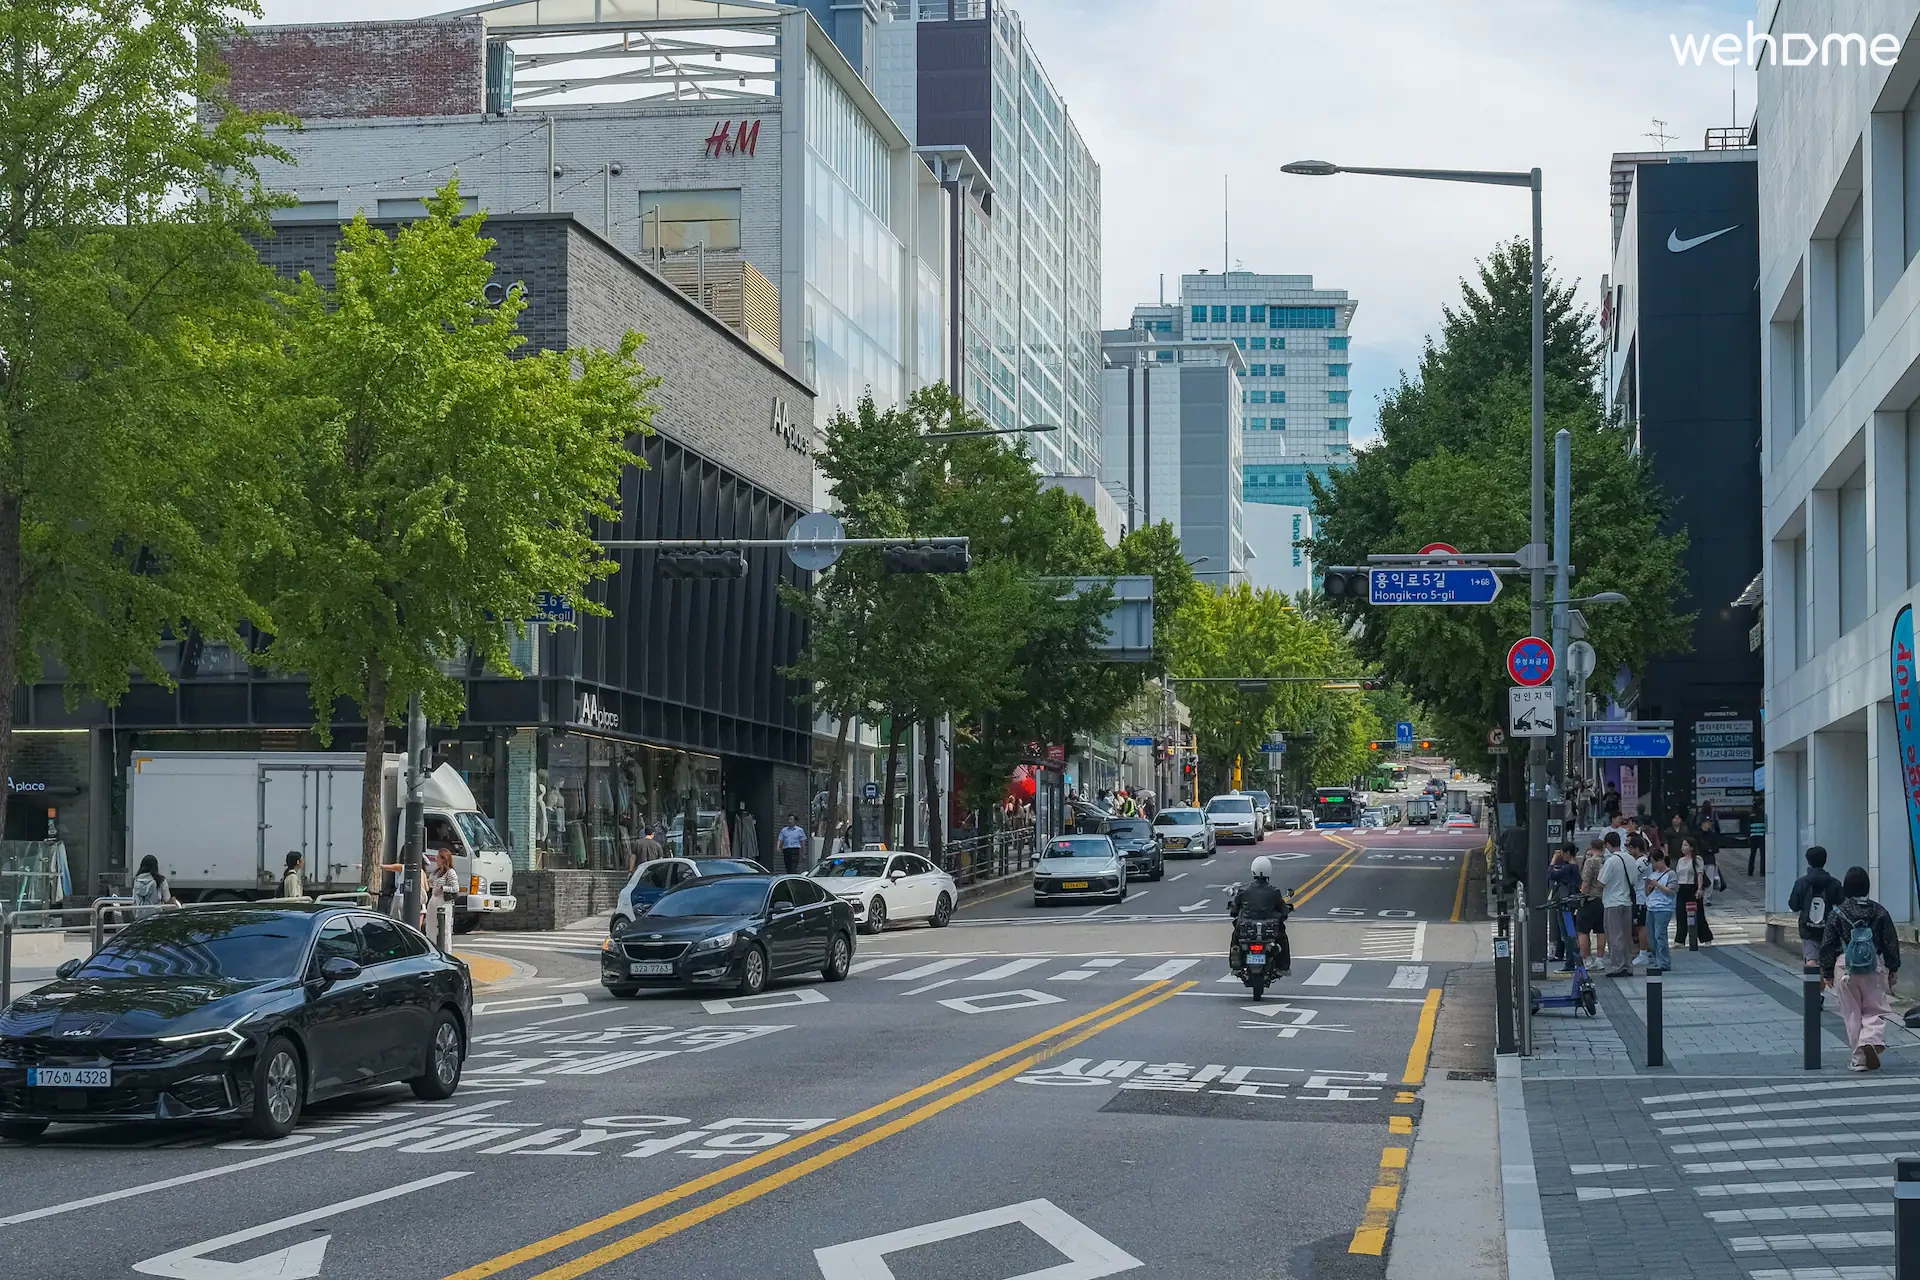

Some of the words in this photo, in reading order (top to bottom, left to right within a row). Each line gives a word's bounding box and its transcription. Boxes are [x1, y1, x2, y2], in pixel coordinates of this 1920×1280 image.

[705, 119, 760, 157] H&M
[1292, 513, 1302, 567] Hanaank
[1375, 572, 1446, 588] 홍익로5길
[1374, 590, 1428, 602] Hongik-ro
[1430, 590, 1455, 602] 5-gil
[1514, 657, 1549, 666] 주정차금지
[1513, 691, 1552, 702] 견인지역
[1327, 907, 1416, 917] 50
[39, 1070, 71, 1084] 176하
[75, 1070, 107, 1084] 4328
[1013, 1057, 1388, 1100] 생활도로
